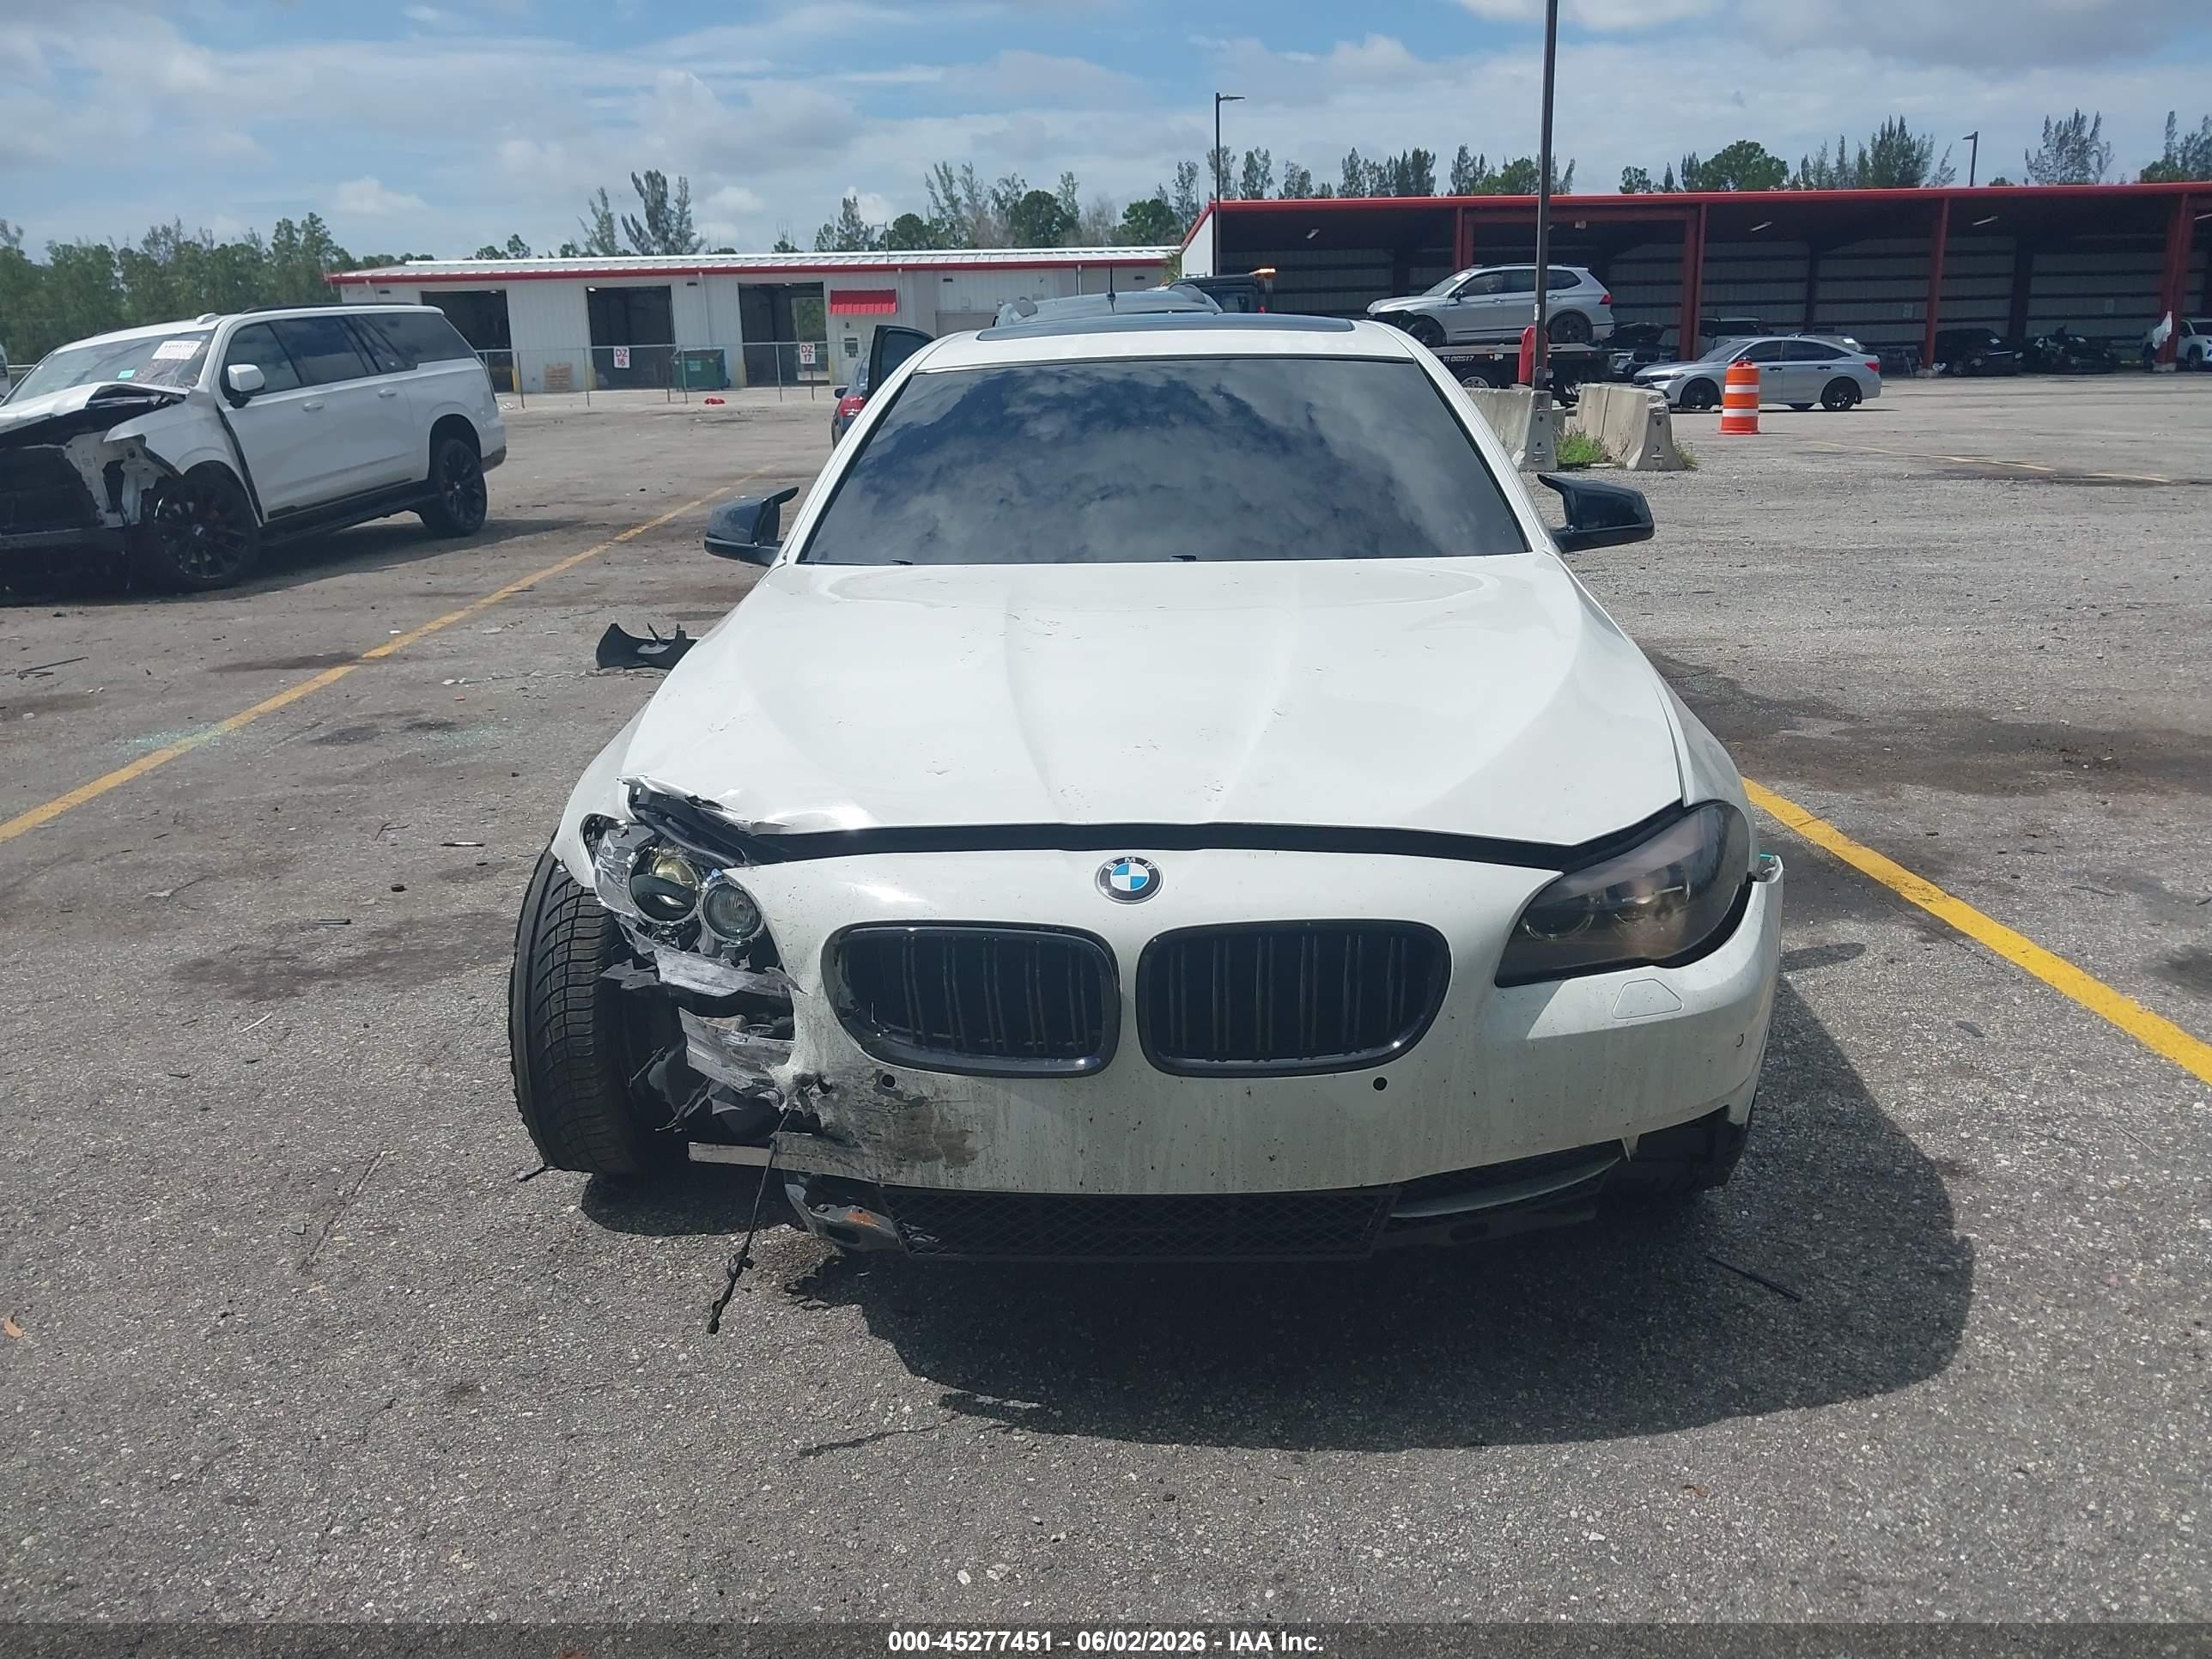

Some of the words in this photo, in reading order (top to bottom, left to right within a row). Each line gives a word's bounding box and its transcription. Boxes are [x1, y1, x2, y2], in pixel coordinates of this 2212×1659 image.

[801, 345, 814, 354] DZ
[804, 354, 812, 362] 17
[1105, 857, 1157, 872] BMW
